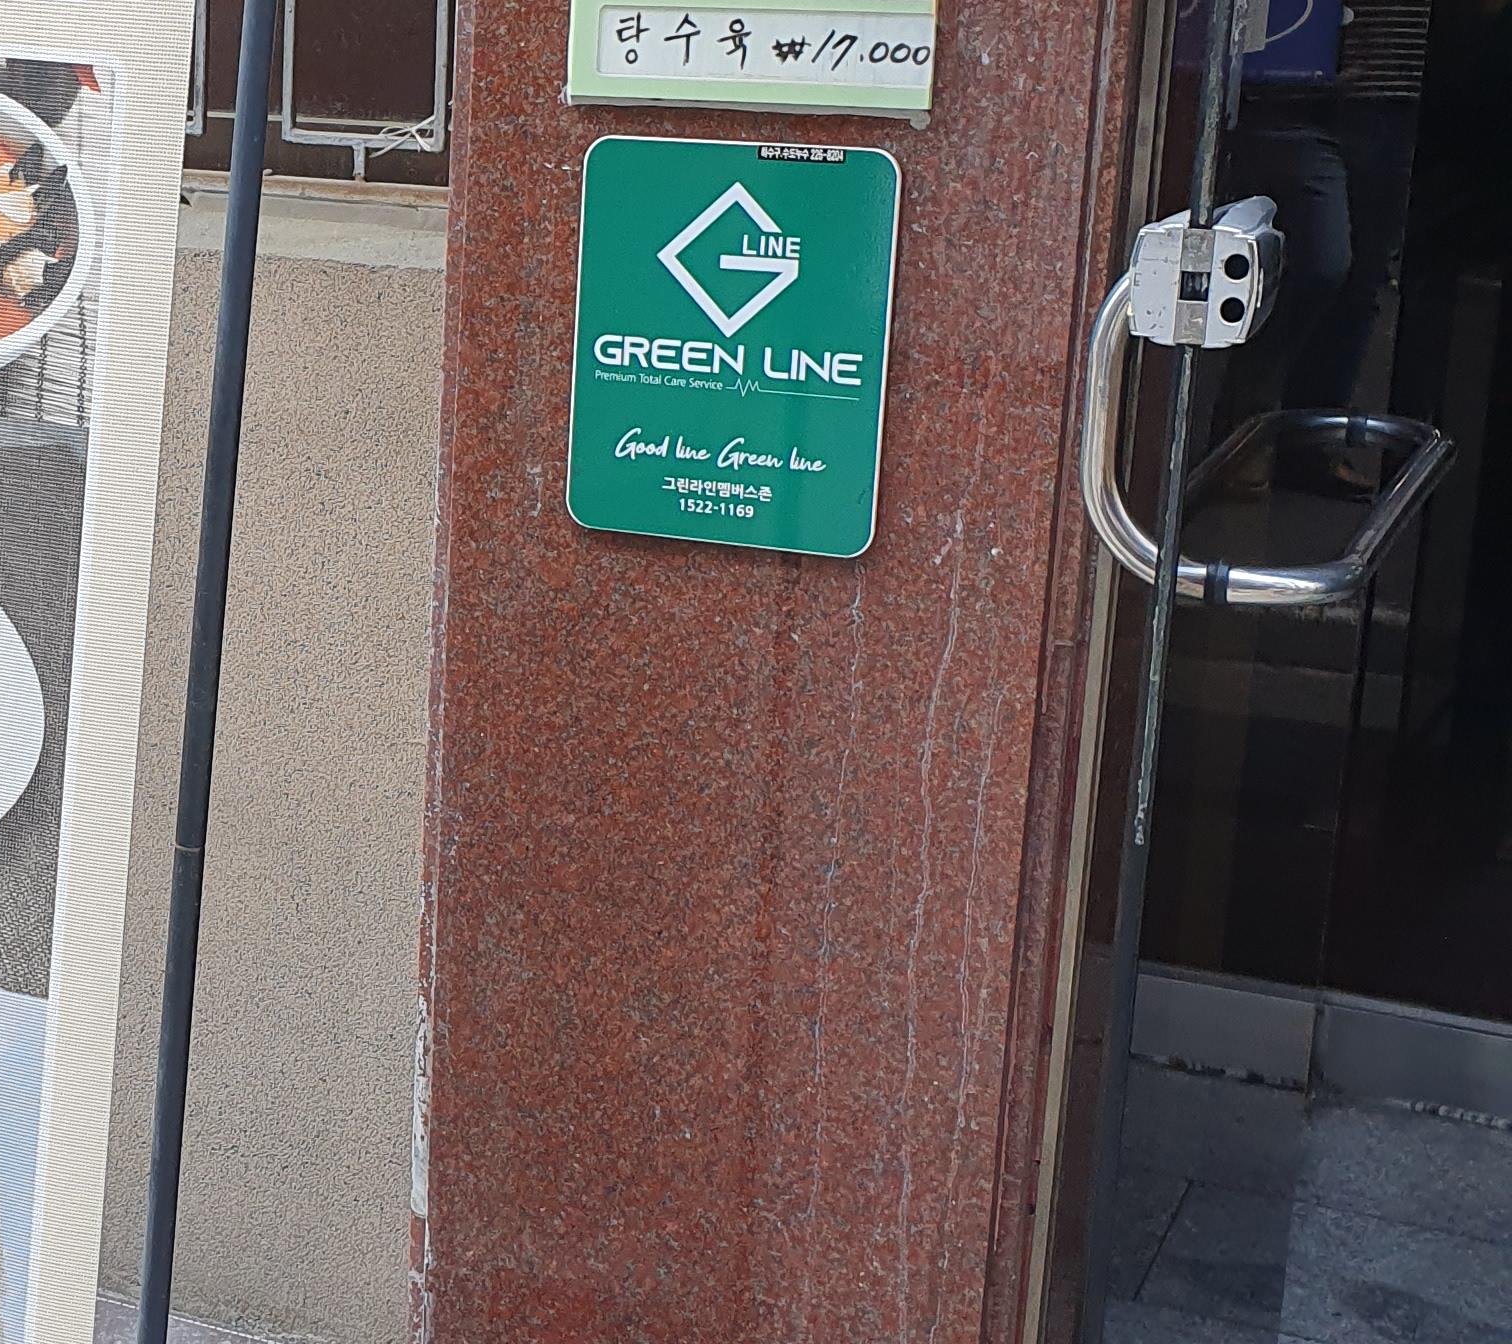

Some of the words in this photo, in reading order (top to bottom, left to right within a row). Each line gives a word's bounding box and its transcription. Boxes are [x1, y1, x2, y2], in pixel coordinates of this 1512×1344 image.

[615, 11, 753, 71] 탕수육
[742, 234, 801, 258] LINE
[593, 334, 745, 376] GREEN
[763, 346, 864, 386] LINE
[594, 370, 637, 384] Premium
[638, 372, 662, 386] Total
[664, 375, 687, 388] Care
[688, 376, 724, 391] Service
[614, 427, 670, 460] Good
[675, 435, 711, 461] line
[716, 437, 784, 471] Green
[789, 446, 827, 472] line
[661, 476, 773, 502] 그린라인멤버스존
[679, 498, 754, 518] 1522-1169
